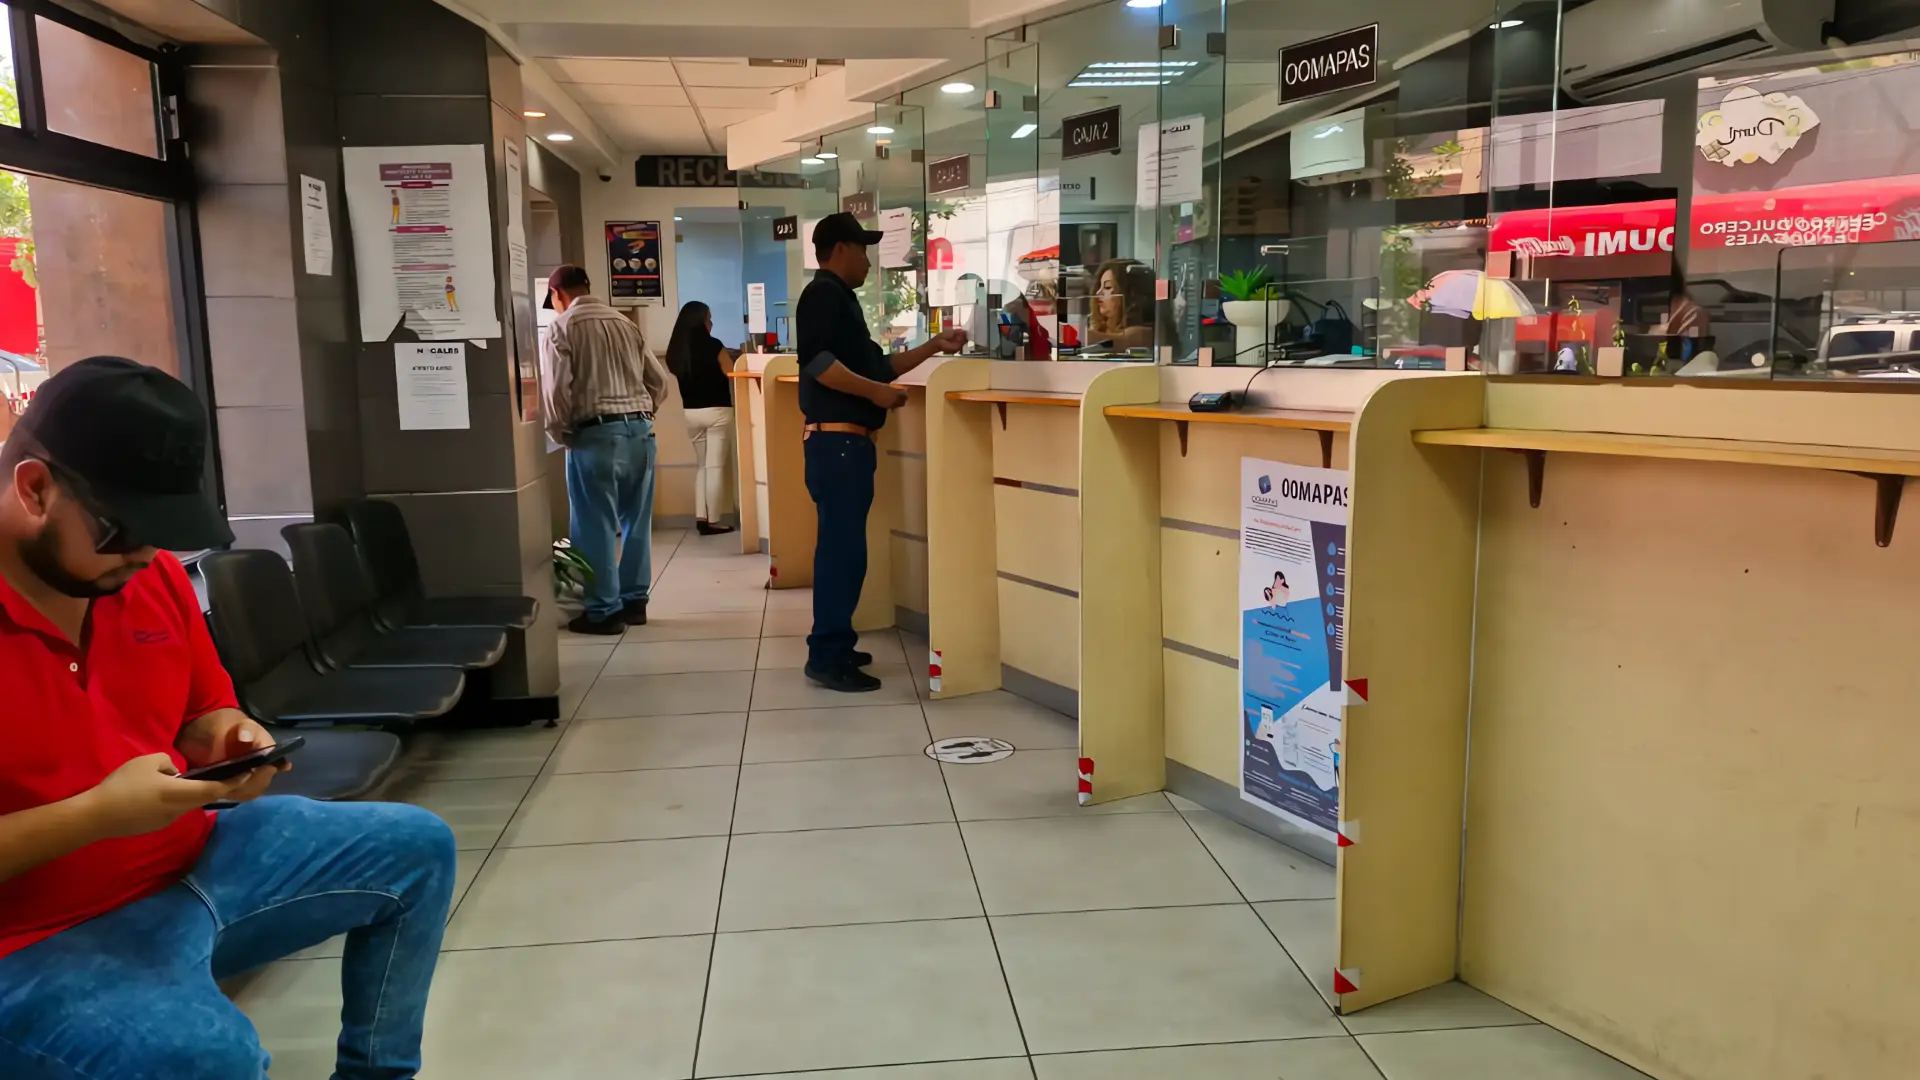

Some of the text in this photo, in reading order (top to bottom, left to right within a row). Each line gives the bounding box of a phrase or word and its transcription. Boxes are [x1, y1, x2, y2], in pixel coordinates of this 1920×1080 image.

[1285, 44, 1370, 85] OOMAPAS
[1102, 122, 1109, 139] 2
[657, 157, 801, 187] RECECI
